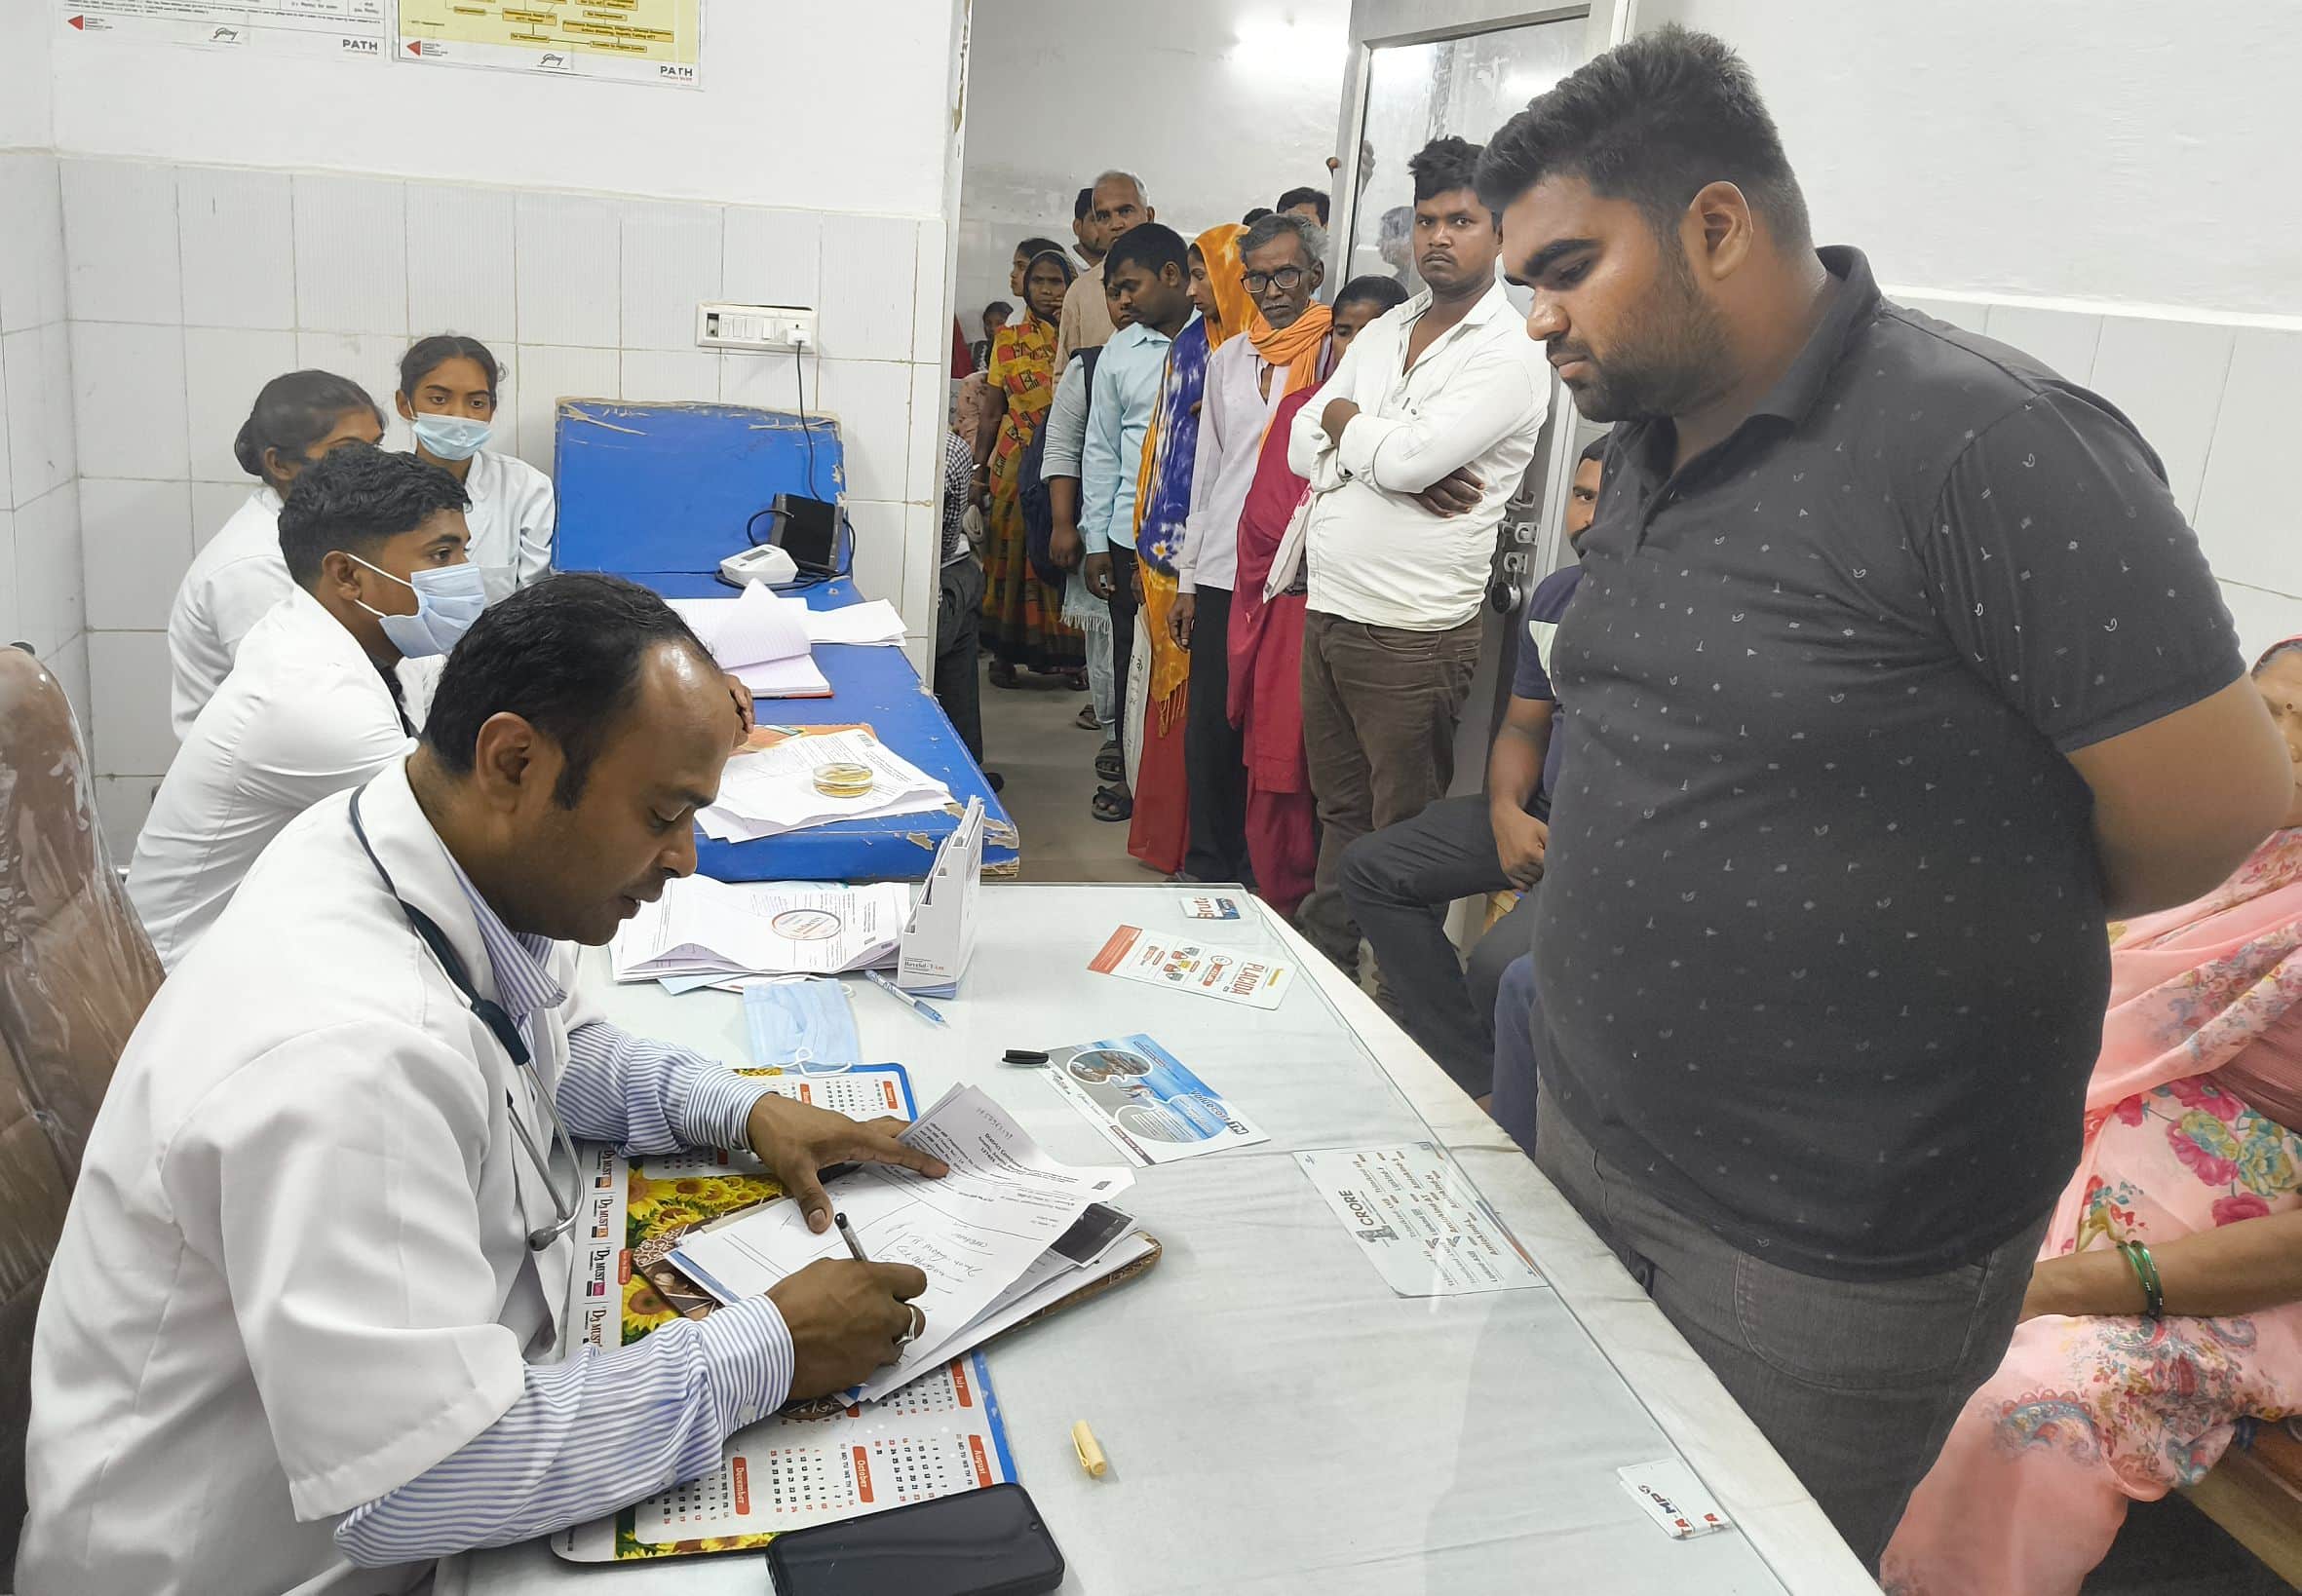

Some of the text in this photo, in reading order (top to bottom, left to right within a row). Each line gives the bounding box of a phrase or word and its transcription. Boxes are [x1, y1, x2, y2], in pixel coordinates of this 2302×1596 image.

[342, 39, 378, 52] PATH
[660, 65, 693, 77] PATH
[1230, 962, 1265, 996] PLACIDA
[599, 1210, 609, 1227] MUST
[1338, 1190, 1374, 1226] CRORE
[595, 1262, 605, 1281] MUST
[591, 1324, 601, 1345] MUST
[858, 1460, 867, 1487] October
[734, 1467, 745, 1504] December
